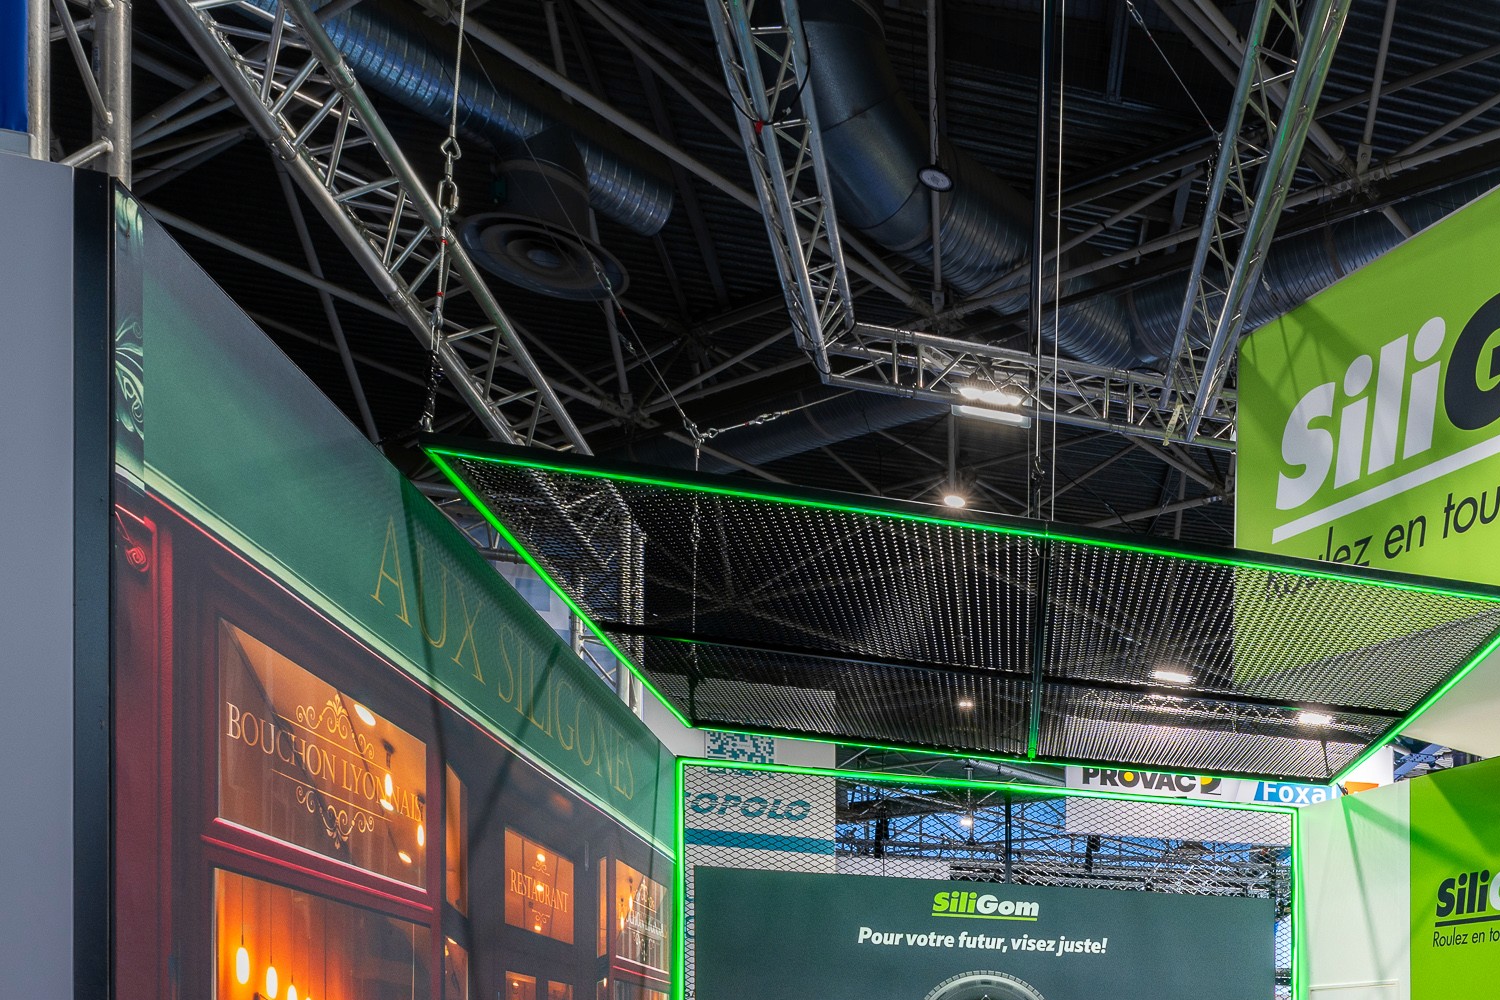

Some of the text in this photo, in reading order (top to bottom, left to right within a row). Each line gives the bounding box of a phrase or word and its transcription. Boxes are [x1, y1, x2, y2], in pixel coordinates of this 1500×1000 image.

[1384, 514, 1426, 559] en
[370, 515, 486, 686] AUX
[226, 701, 422, 822] BOUCHON LYONNAIS
[1082, 766, 1198, 793] PROVAC
[510, 869, 569, 912] RESTAURANT
[932, 891, 1040, 917] SiliGom
[858, 927, 1108, 956] Pour votre futur, visez juste!
[1433, 927, 1468, 947] Roulez
[1472, 931, 1485, 943] en
